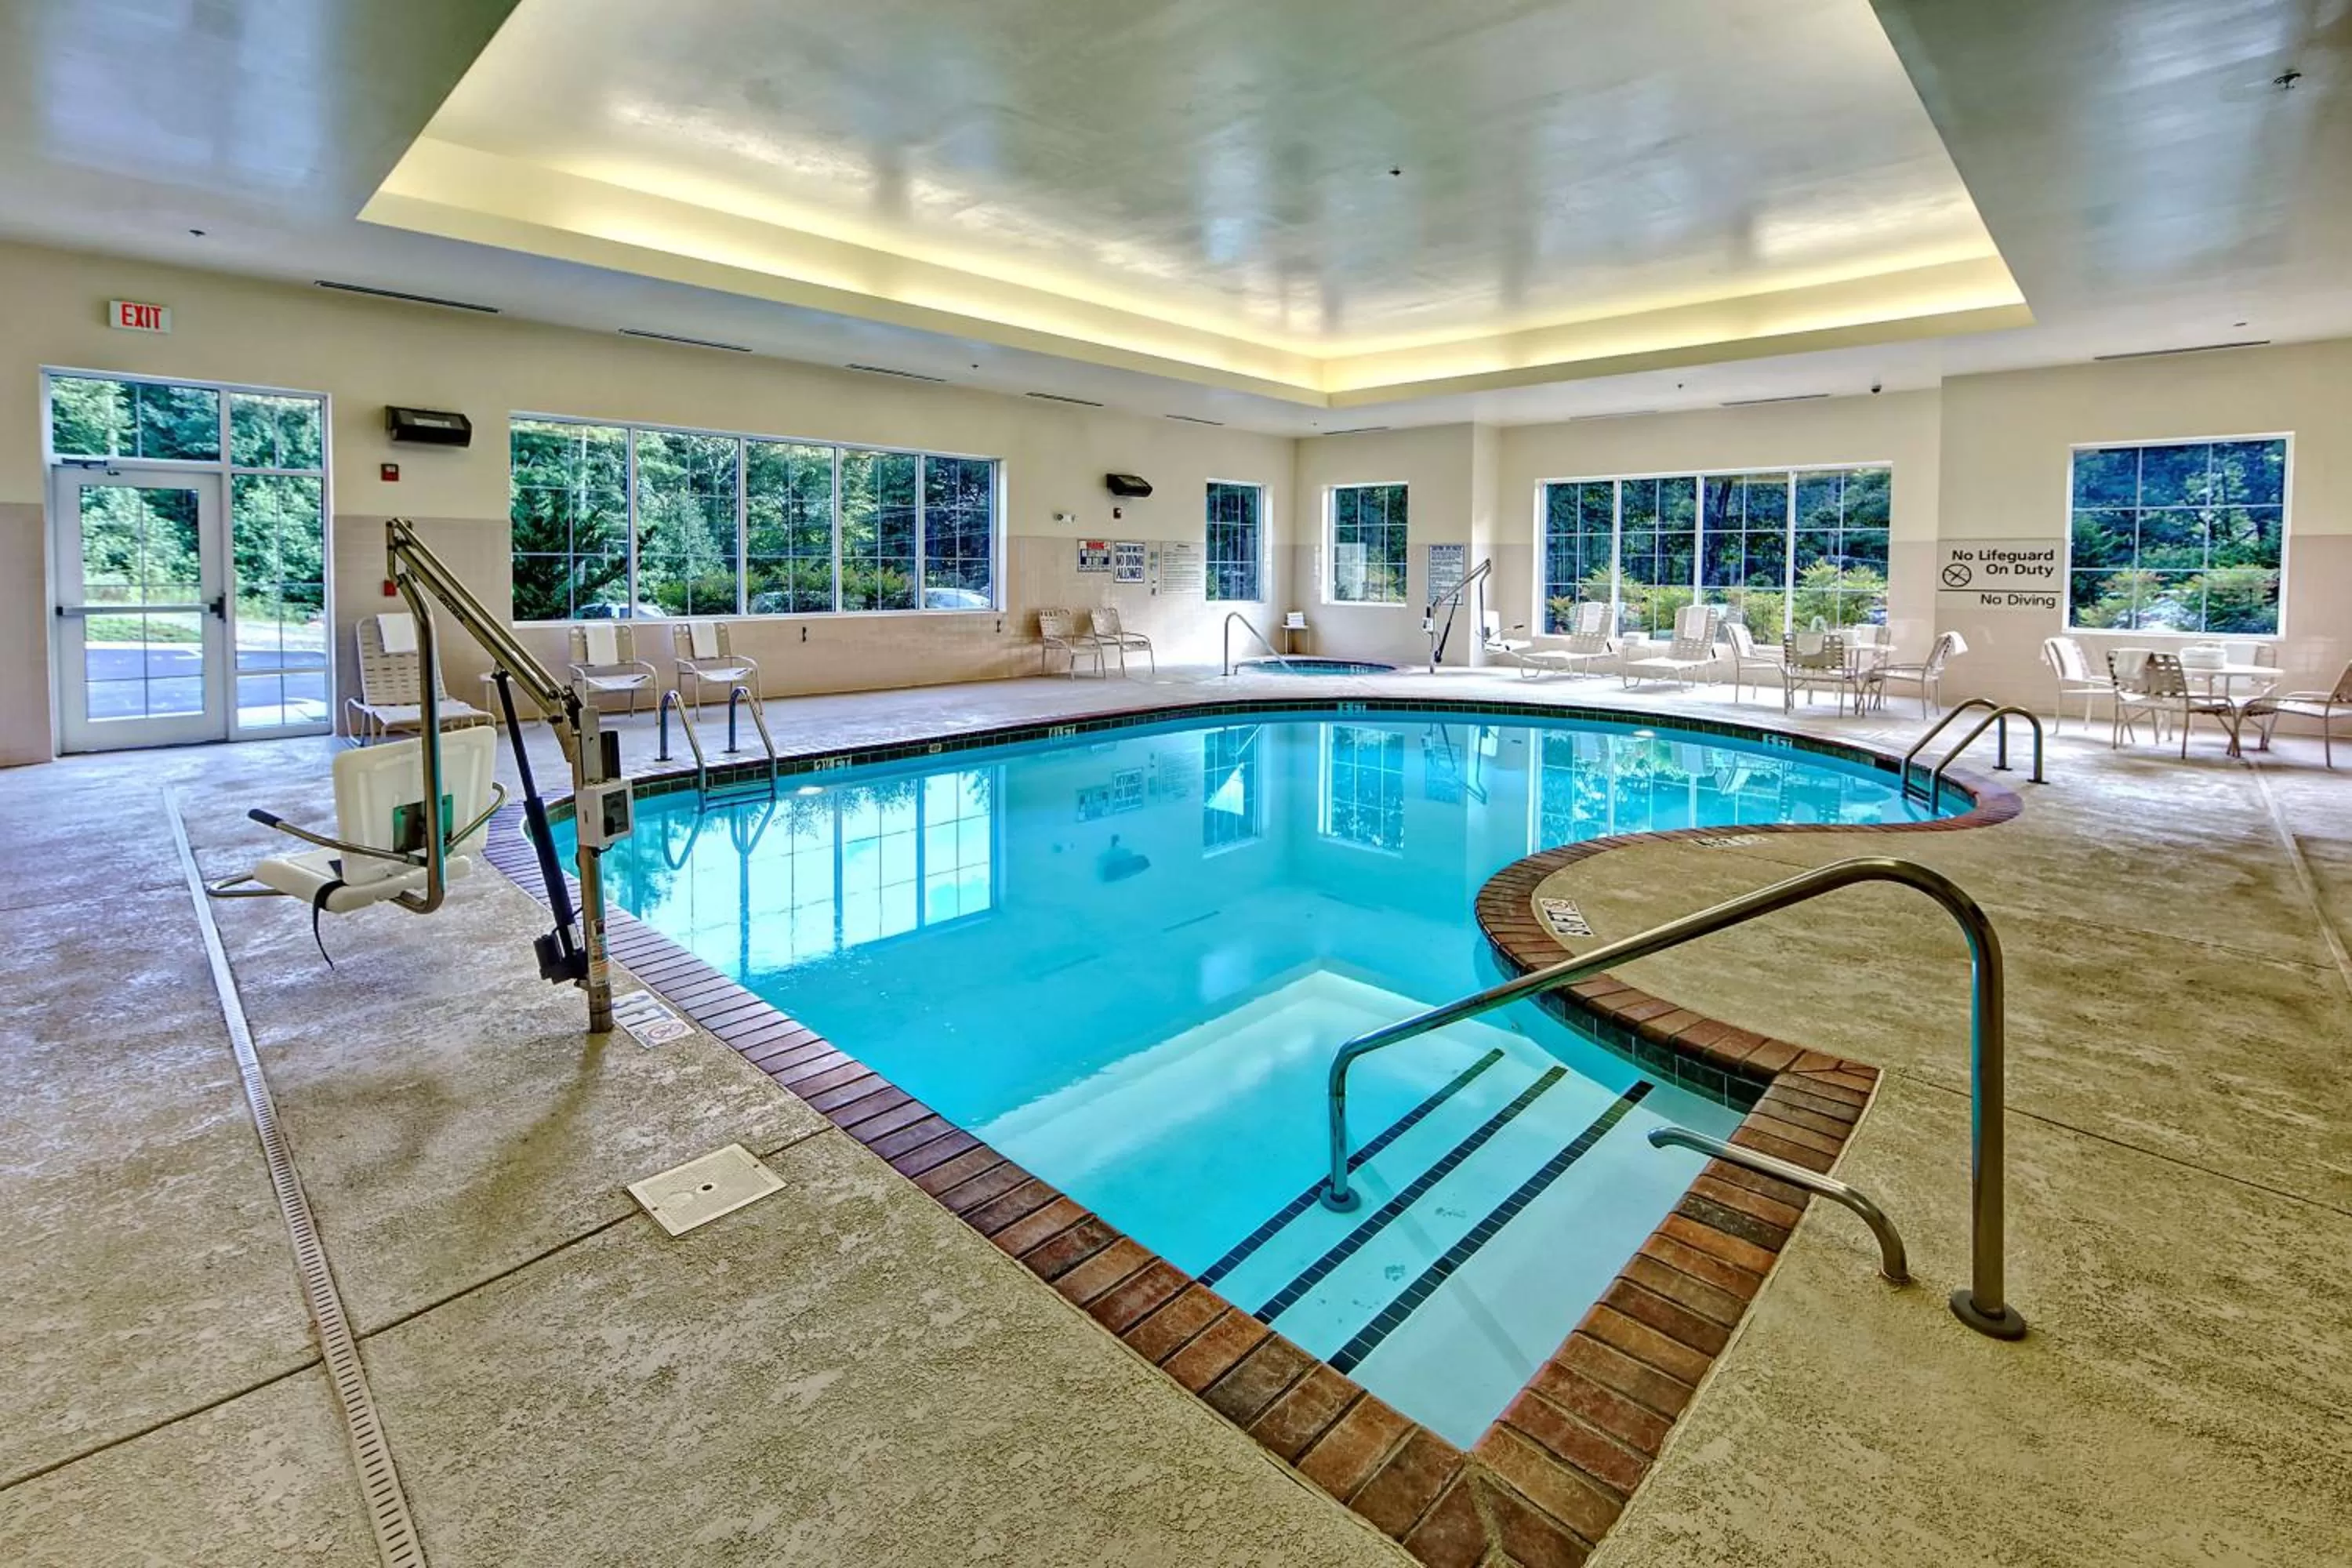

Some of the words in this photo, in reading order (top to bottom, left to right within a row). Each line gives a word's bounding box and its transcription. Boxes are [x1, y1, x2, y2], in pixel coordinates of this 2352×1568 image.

[121, 303, 162, 329] EXIT
[1116, 554, 1124, 566] NO
[1126, 554, 1144, 566] DIVING
[1951, 549, 1973, 561] No
[1978, 549, 2054, 564] Lifeguard
[1986, 564, 2008, 575] On
[2014, 564, 2054, 578] Duty
[1980, 593, 2002, 605] No
[2007, 593, 2056, 609] Diving
